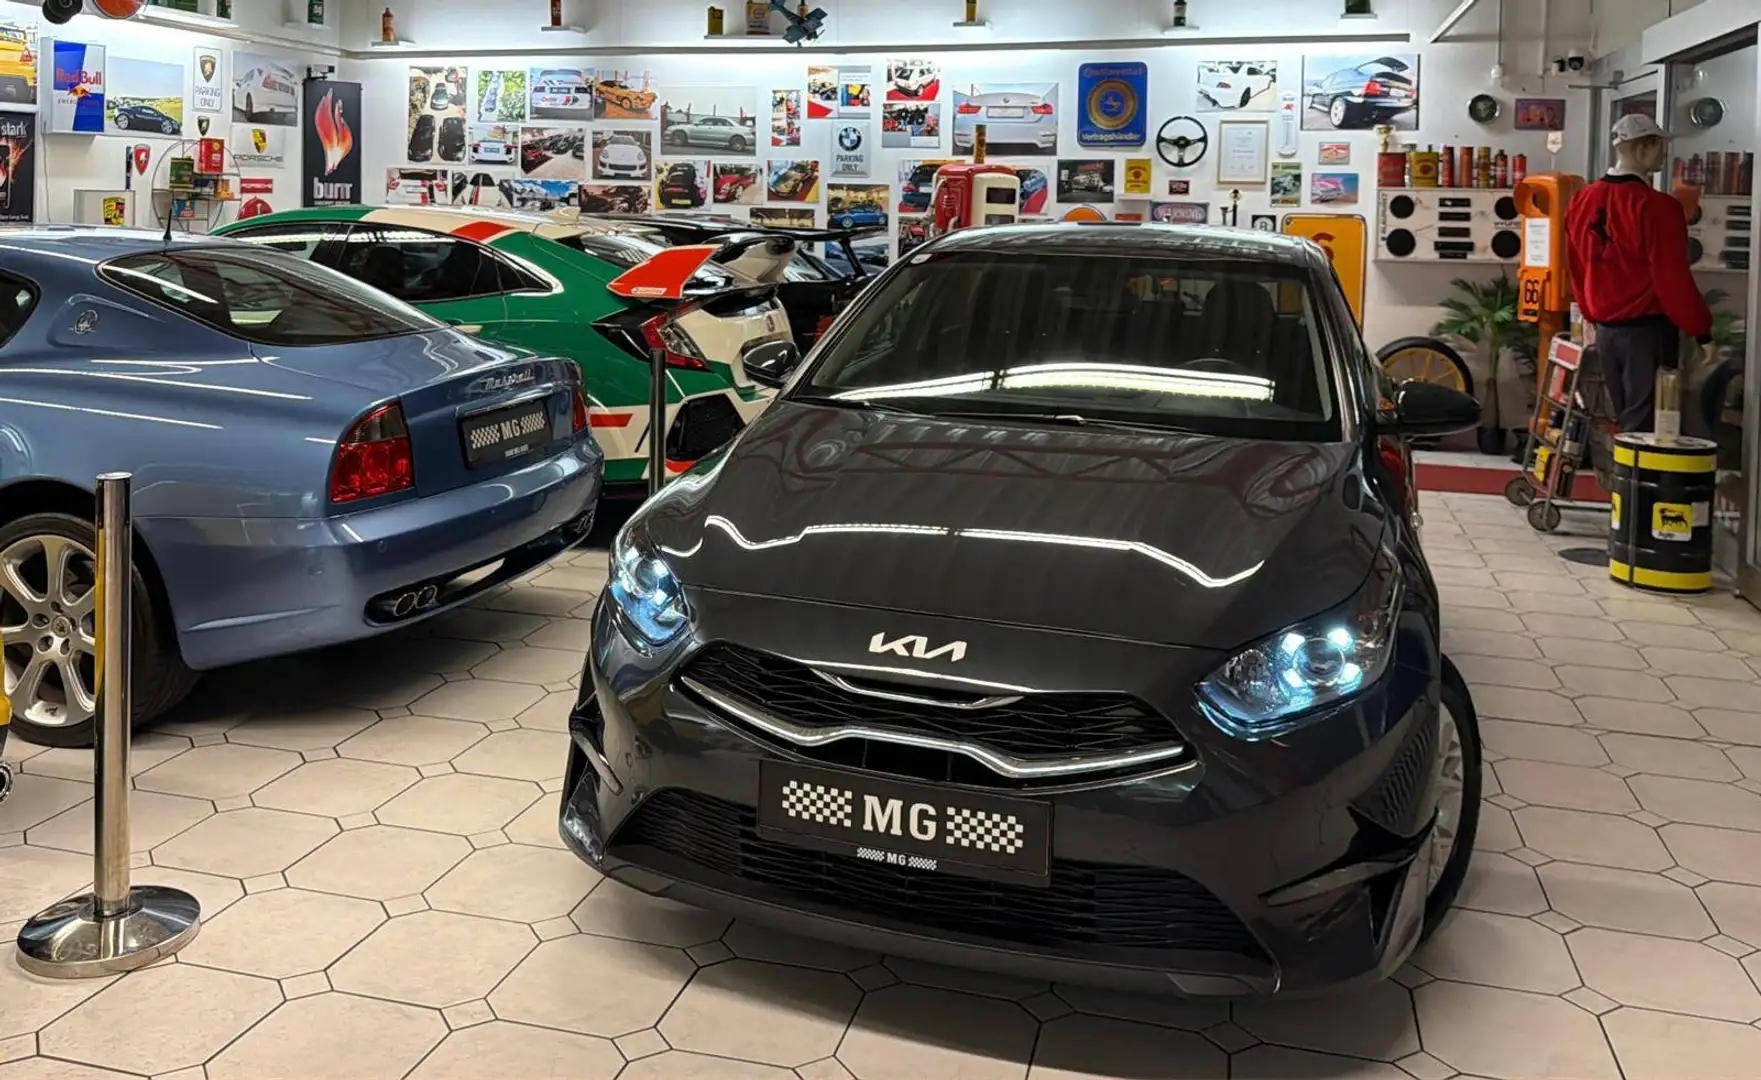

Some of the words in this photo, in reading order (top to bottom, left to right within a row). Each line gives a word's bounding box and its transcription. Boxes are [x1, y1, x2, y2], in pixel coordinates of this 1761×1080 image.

[56, 66, 80, 82] Red
[80, 70, 102, 85] Bull
[194, 85, 221, 97] PARKING
[200, 98, 216, 107] ONLY
[1, 121, 28, 136] stark
[233, 153, 283, 162] PORSCHE
[836, 153, 864, 162] PARKING
[841, 163, 859, 172] ONLY
[313, 177, 353, 199] burn
[500, 419, 521, 440] MG
[869, 631, 968, 662] KIA
[862, 794, 937, 841] MG
[886, 852, 907, 866] MG
